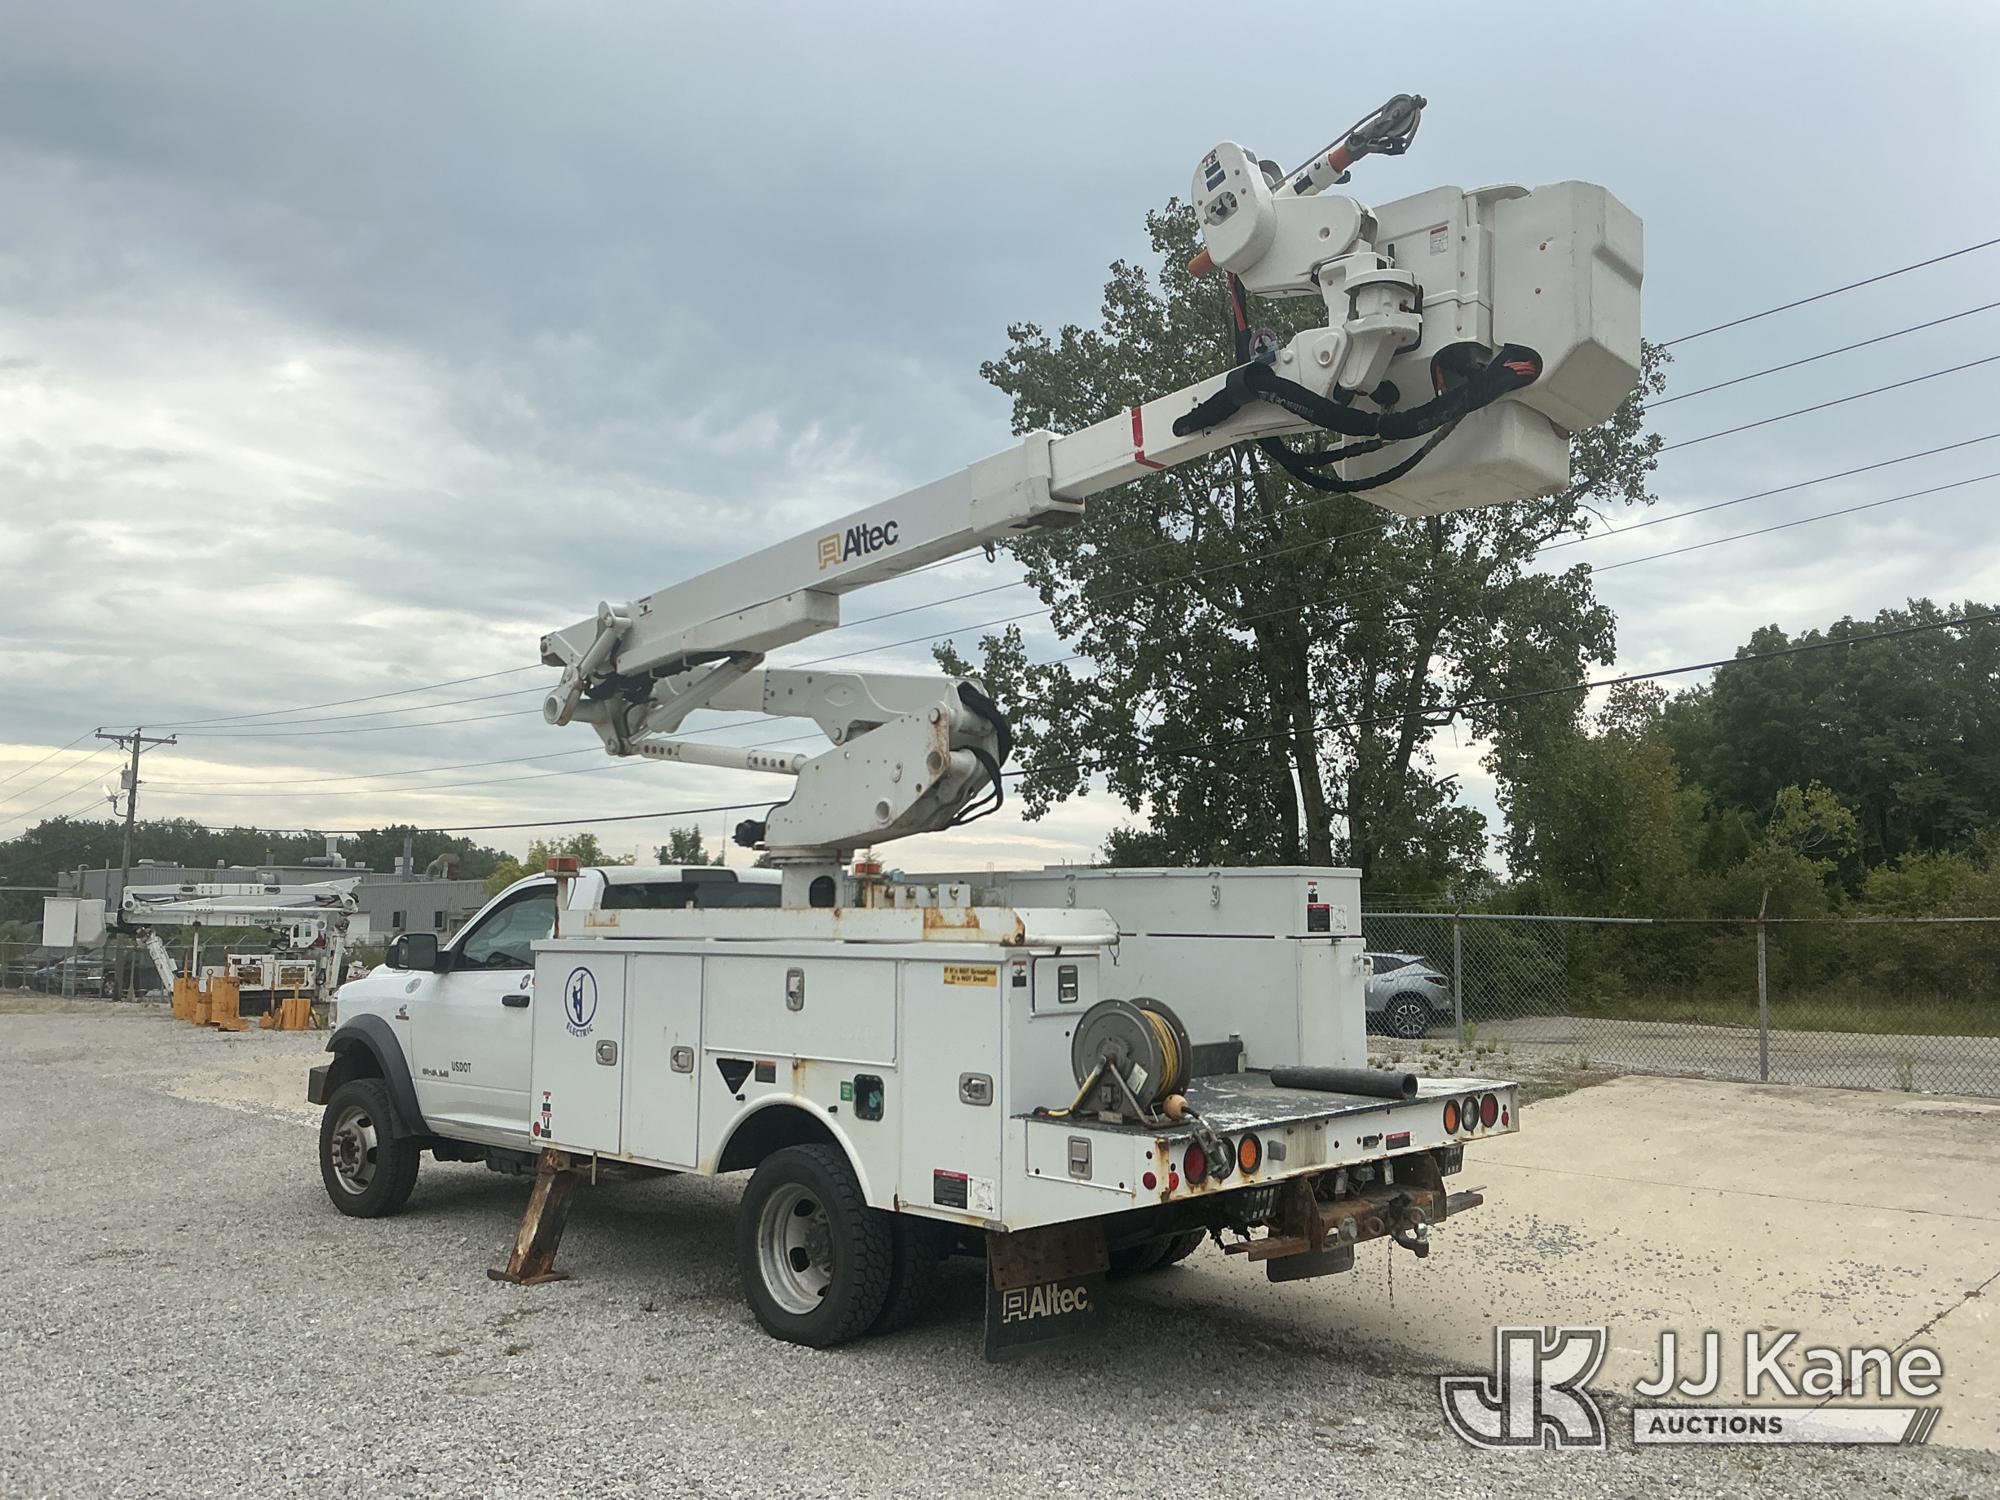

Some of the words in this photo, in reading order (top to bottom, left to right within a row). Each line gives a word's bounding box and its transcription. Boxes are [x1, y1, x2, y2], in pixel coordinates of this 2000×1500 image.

[843, 521, 899, 562] Altec
[566, 1022, 594, 1037] ELECTRIC
[451, 1061, 472, 1073] USDOT
[1029, 1282, 1088, 1319] Altec
